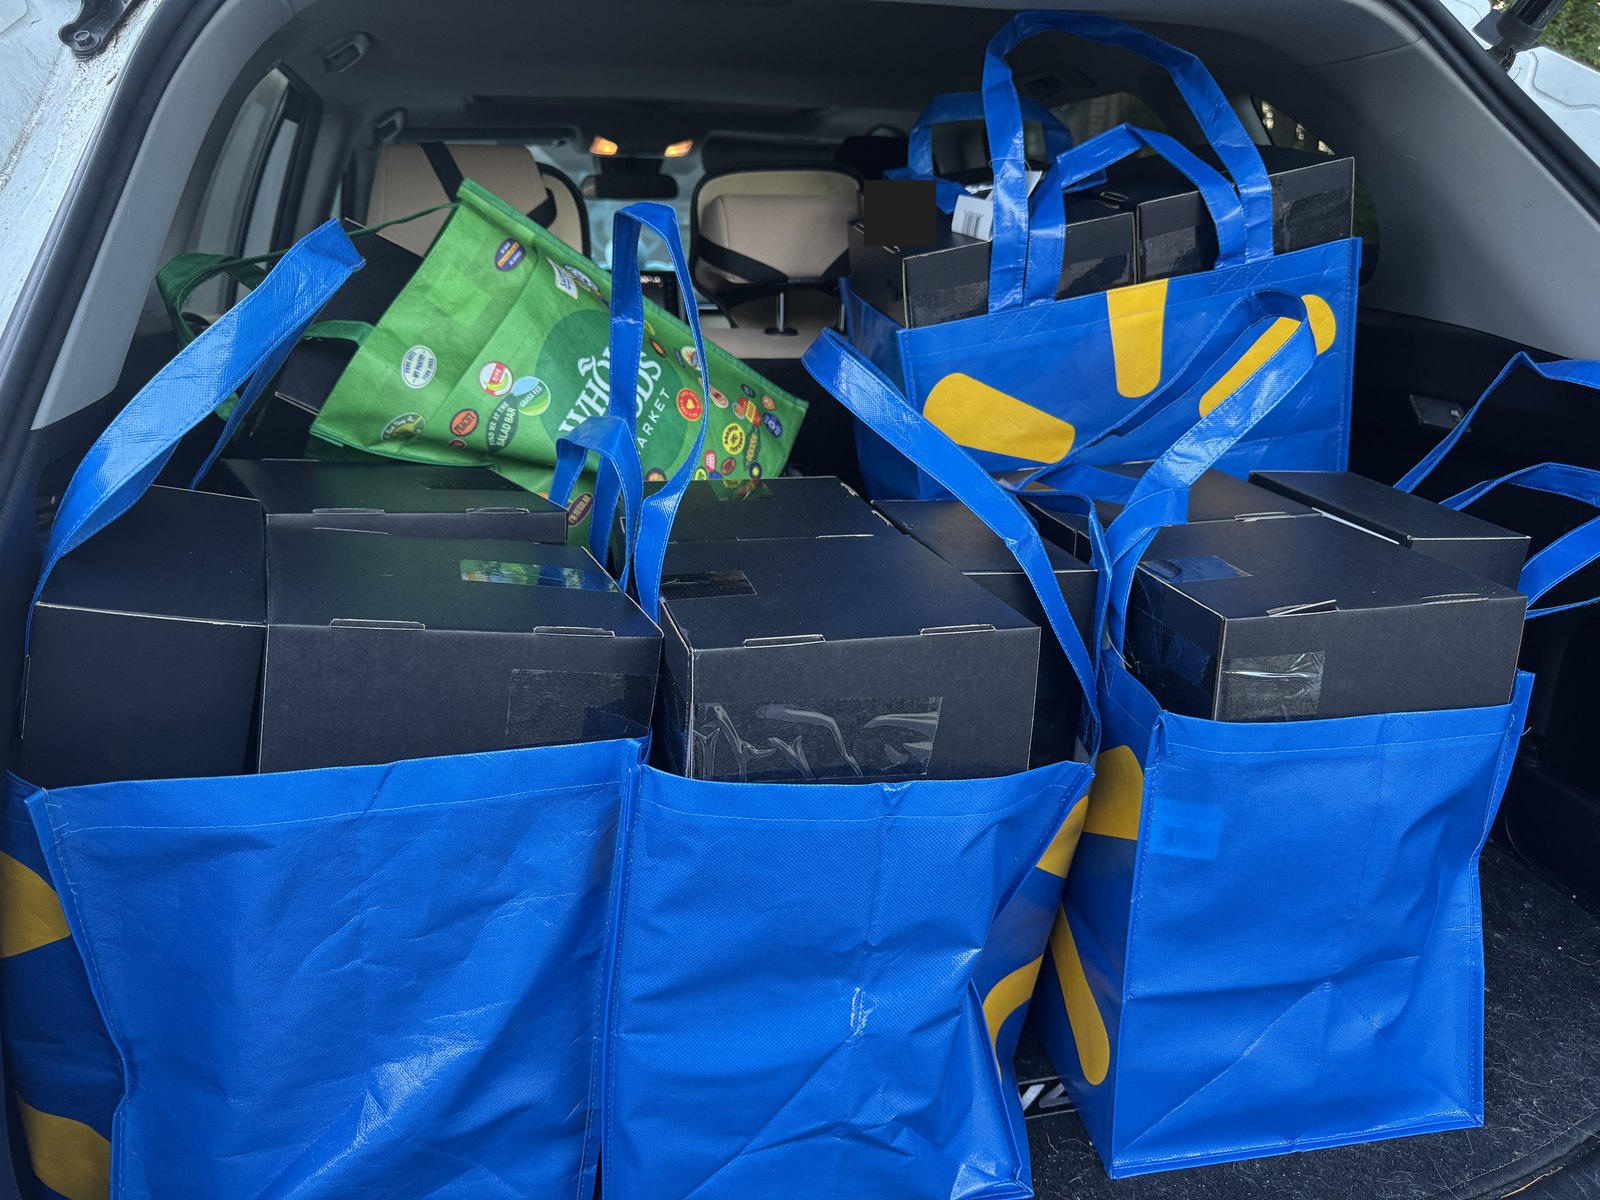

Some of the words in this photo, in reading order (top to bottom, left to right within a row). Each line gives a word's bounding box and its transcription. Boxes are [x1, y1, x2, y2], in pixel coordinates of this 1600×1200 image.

[496, 422, 511, 447] SALAD
[504, 407, 517, 424] BAR
[636, 387, 670, 454] ARKET
